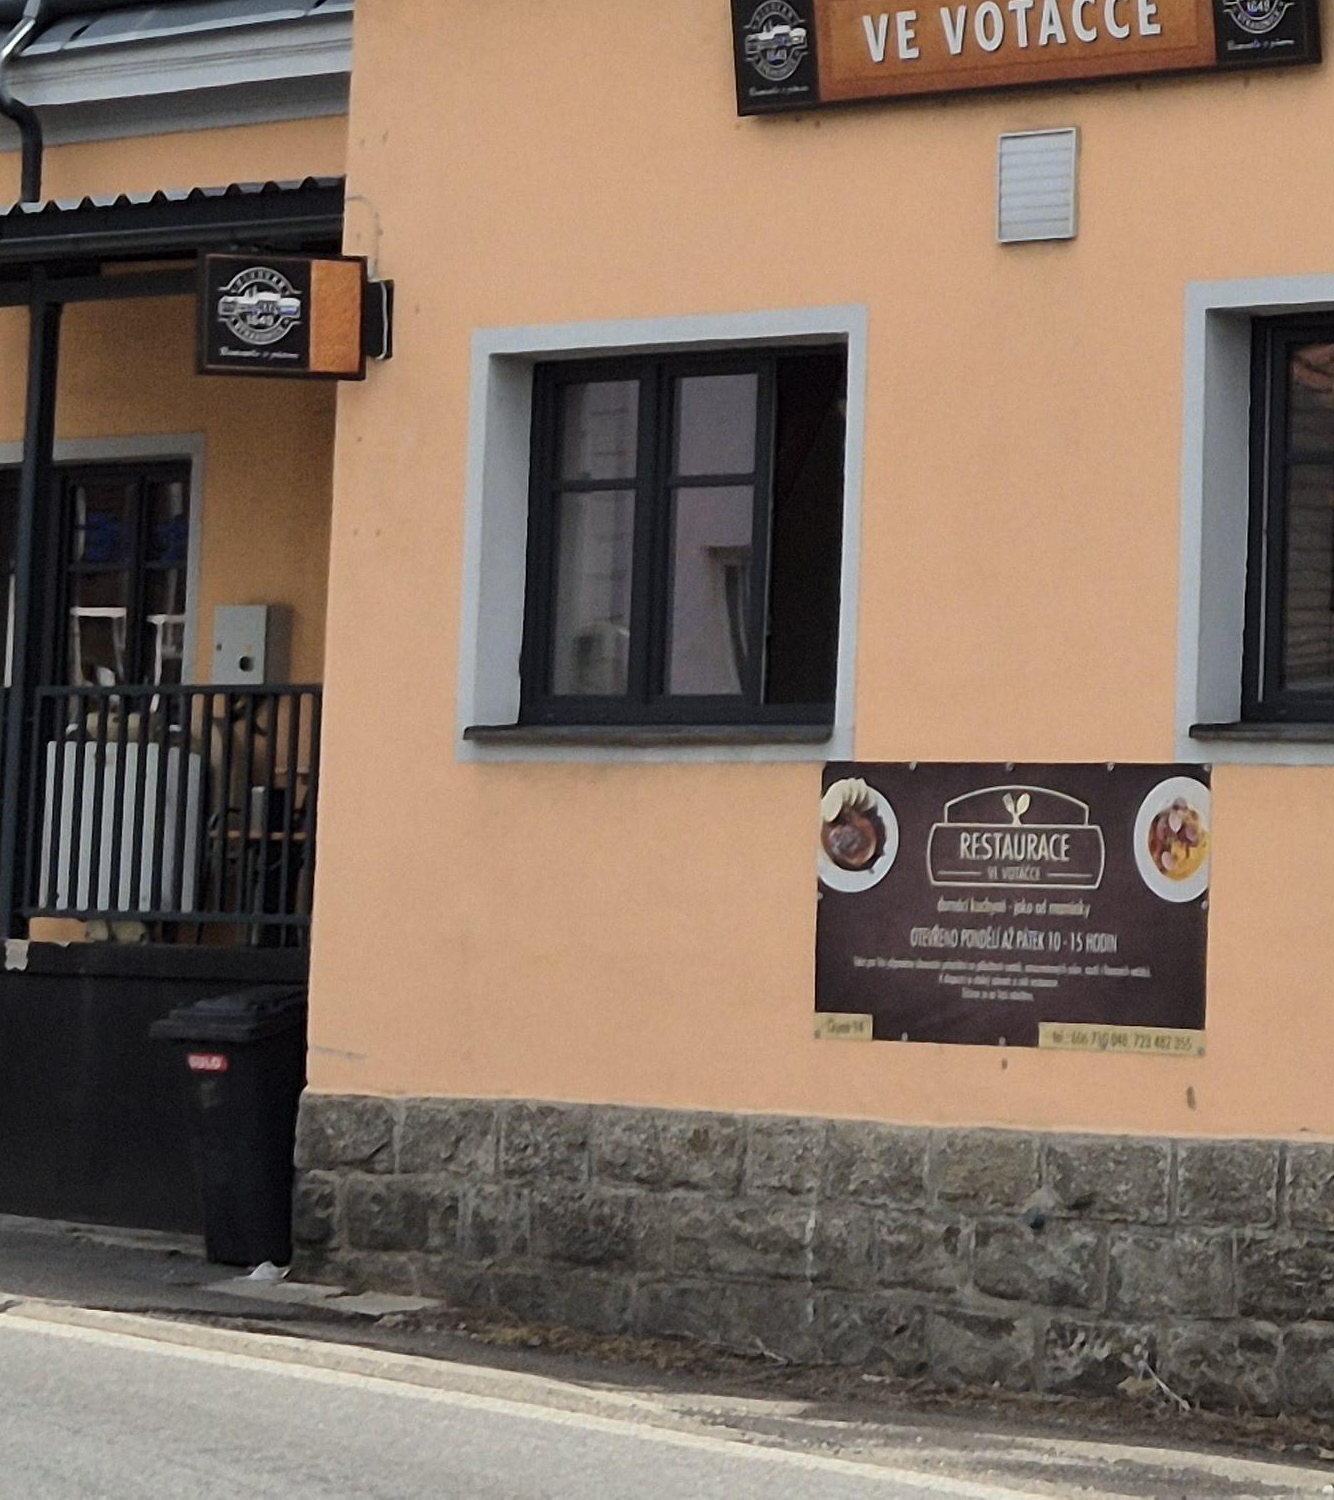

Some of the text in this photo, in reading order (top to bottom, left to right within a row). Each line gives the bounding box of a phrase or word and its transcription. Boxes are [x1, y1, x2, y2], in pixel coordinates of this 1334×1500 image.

[862, 11, 921, 62] VE
[960, 831, 1070, 861] RESTAURACE
[910, 924, 958, 948] OTEVŘENO
[1016, 927, 1045, 950] PÁTEK
[1048, 931, 1062, 952] 10
[1071, 932, 1083, 952] 15
[1086, 932, 1118, 954] HODIN
